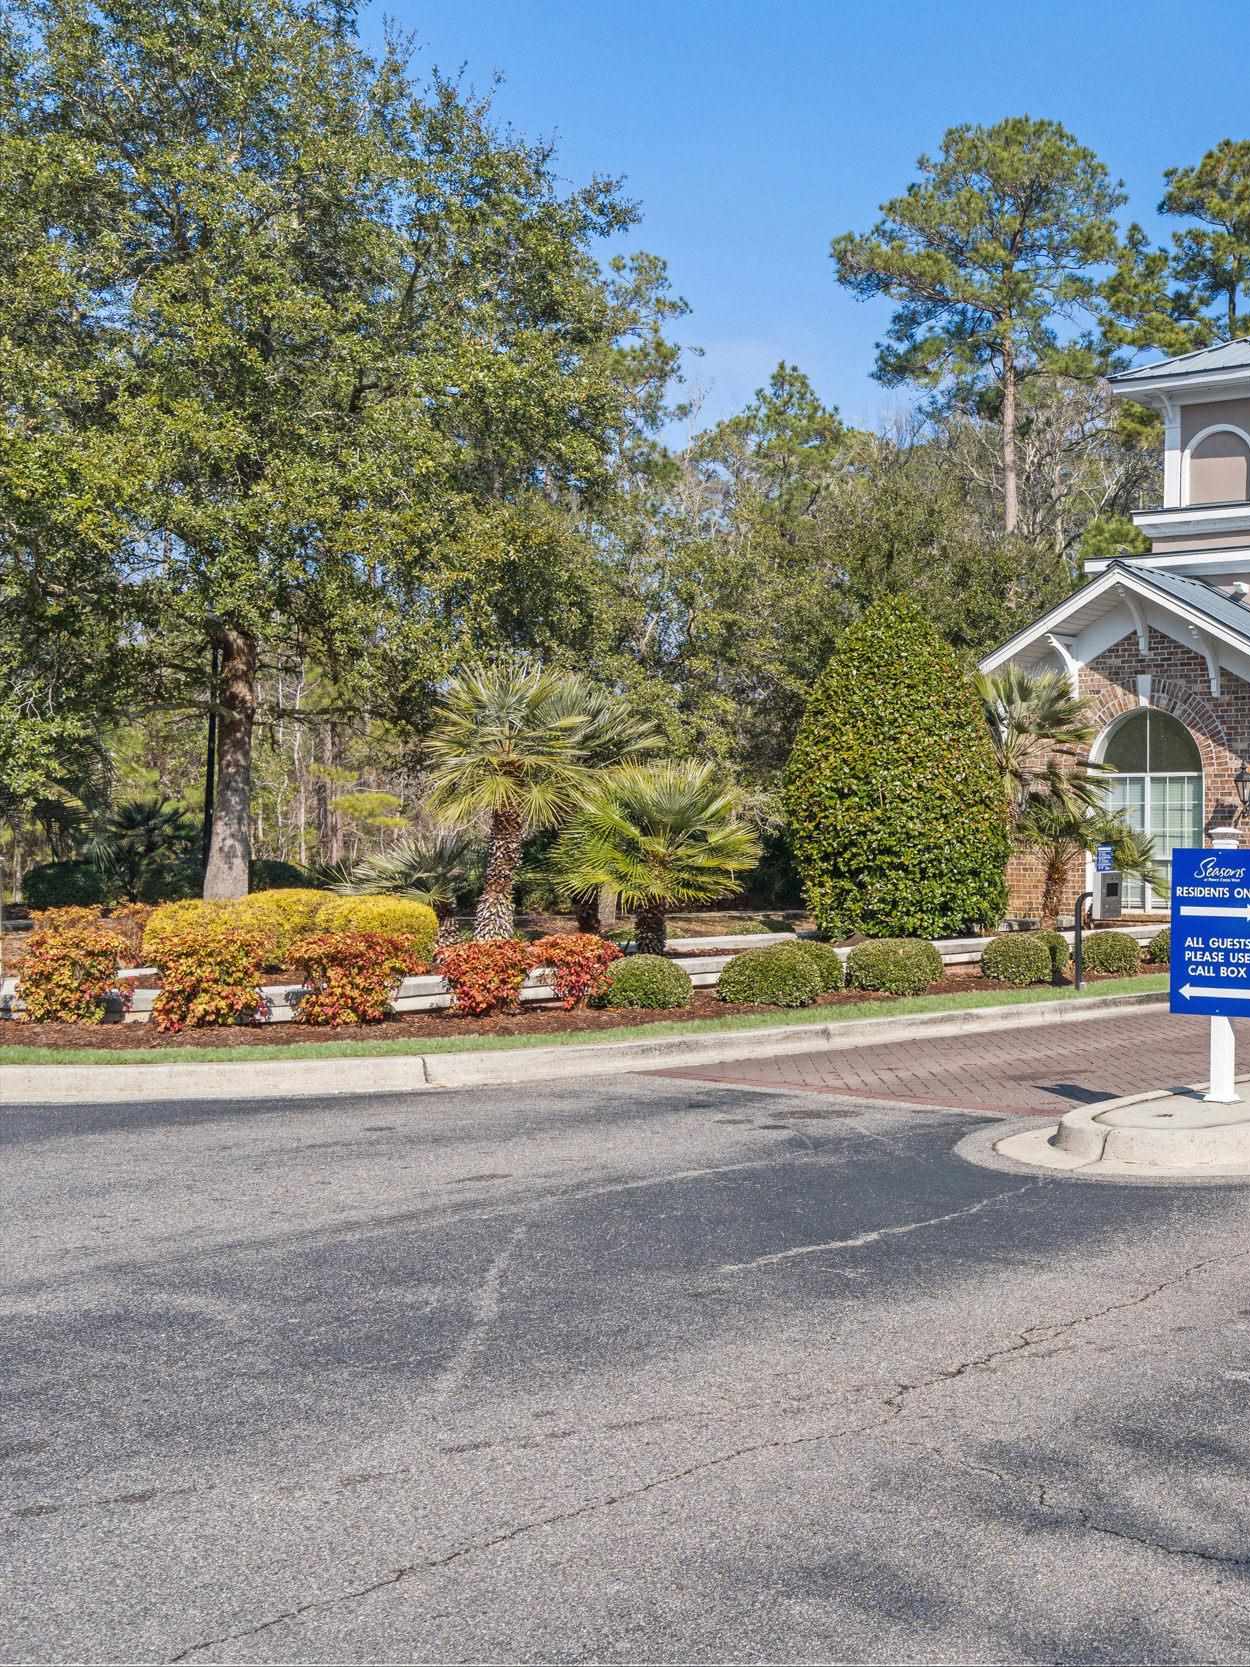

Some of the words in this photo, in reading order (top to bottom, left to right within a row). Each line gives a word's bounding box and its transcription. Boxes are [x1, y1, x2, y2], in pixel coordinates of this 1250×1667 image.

[1194, 857, 1246, 878] Seasons
[1176, 886, 1230, 898] RESIDENTS
[1185, 937, 1205, 948] ALL
[1185, 951, 1225, 962] PLEASE
[1229, 953, 1250, 964] USE
[1188, 965, 1216, 977] CALL
[1220, 967, 1247, 978] BOX
